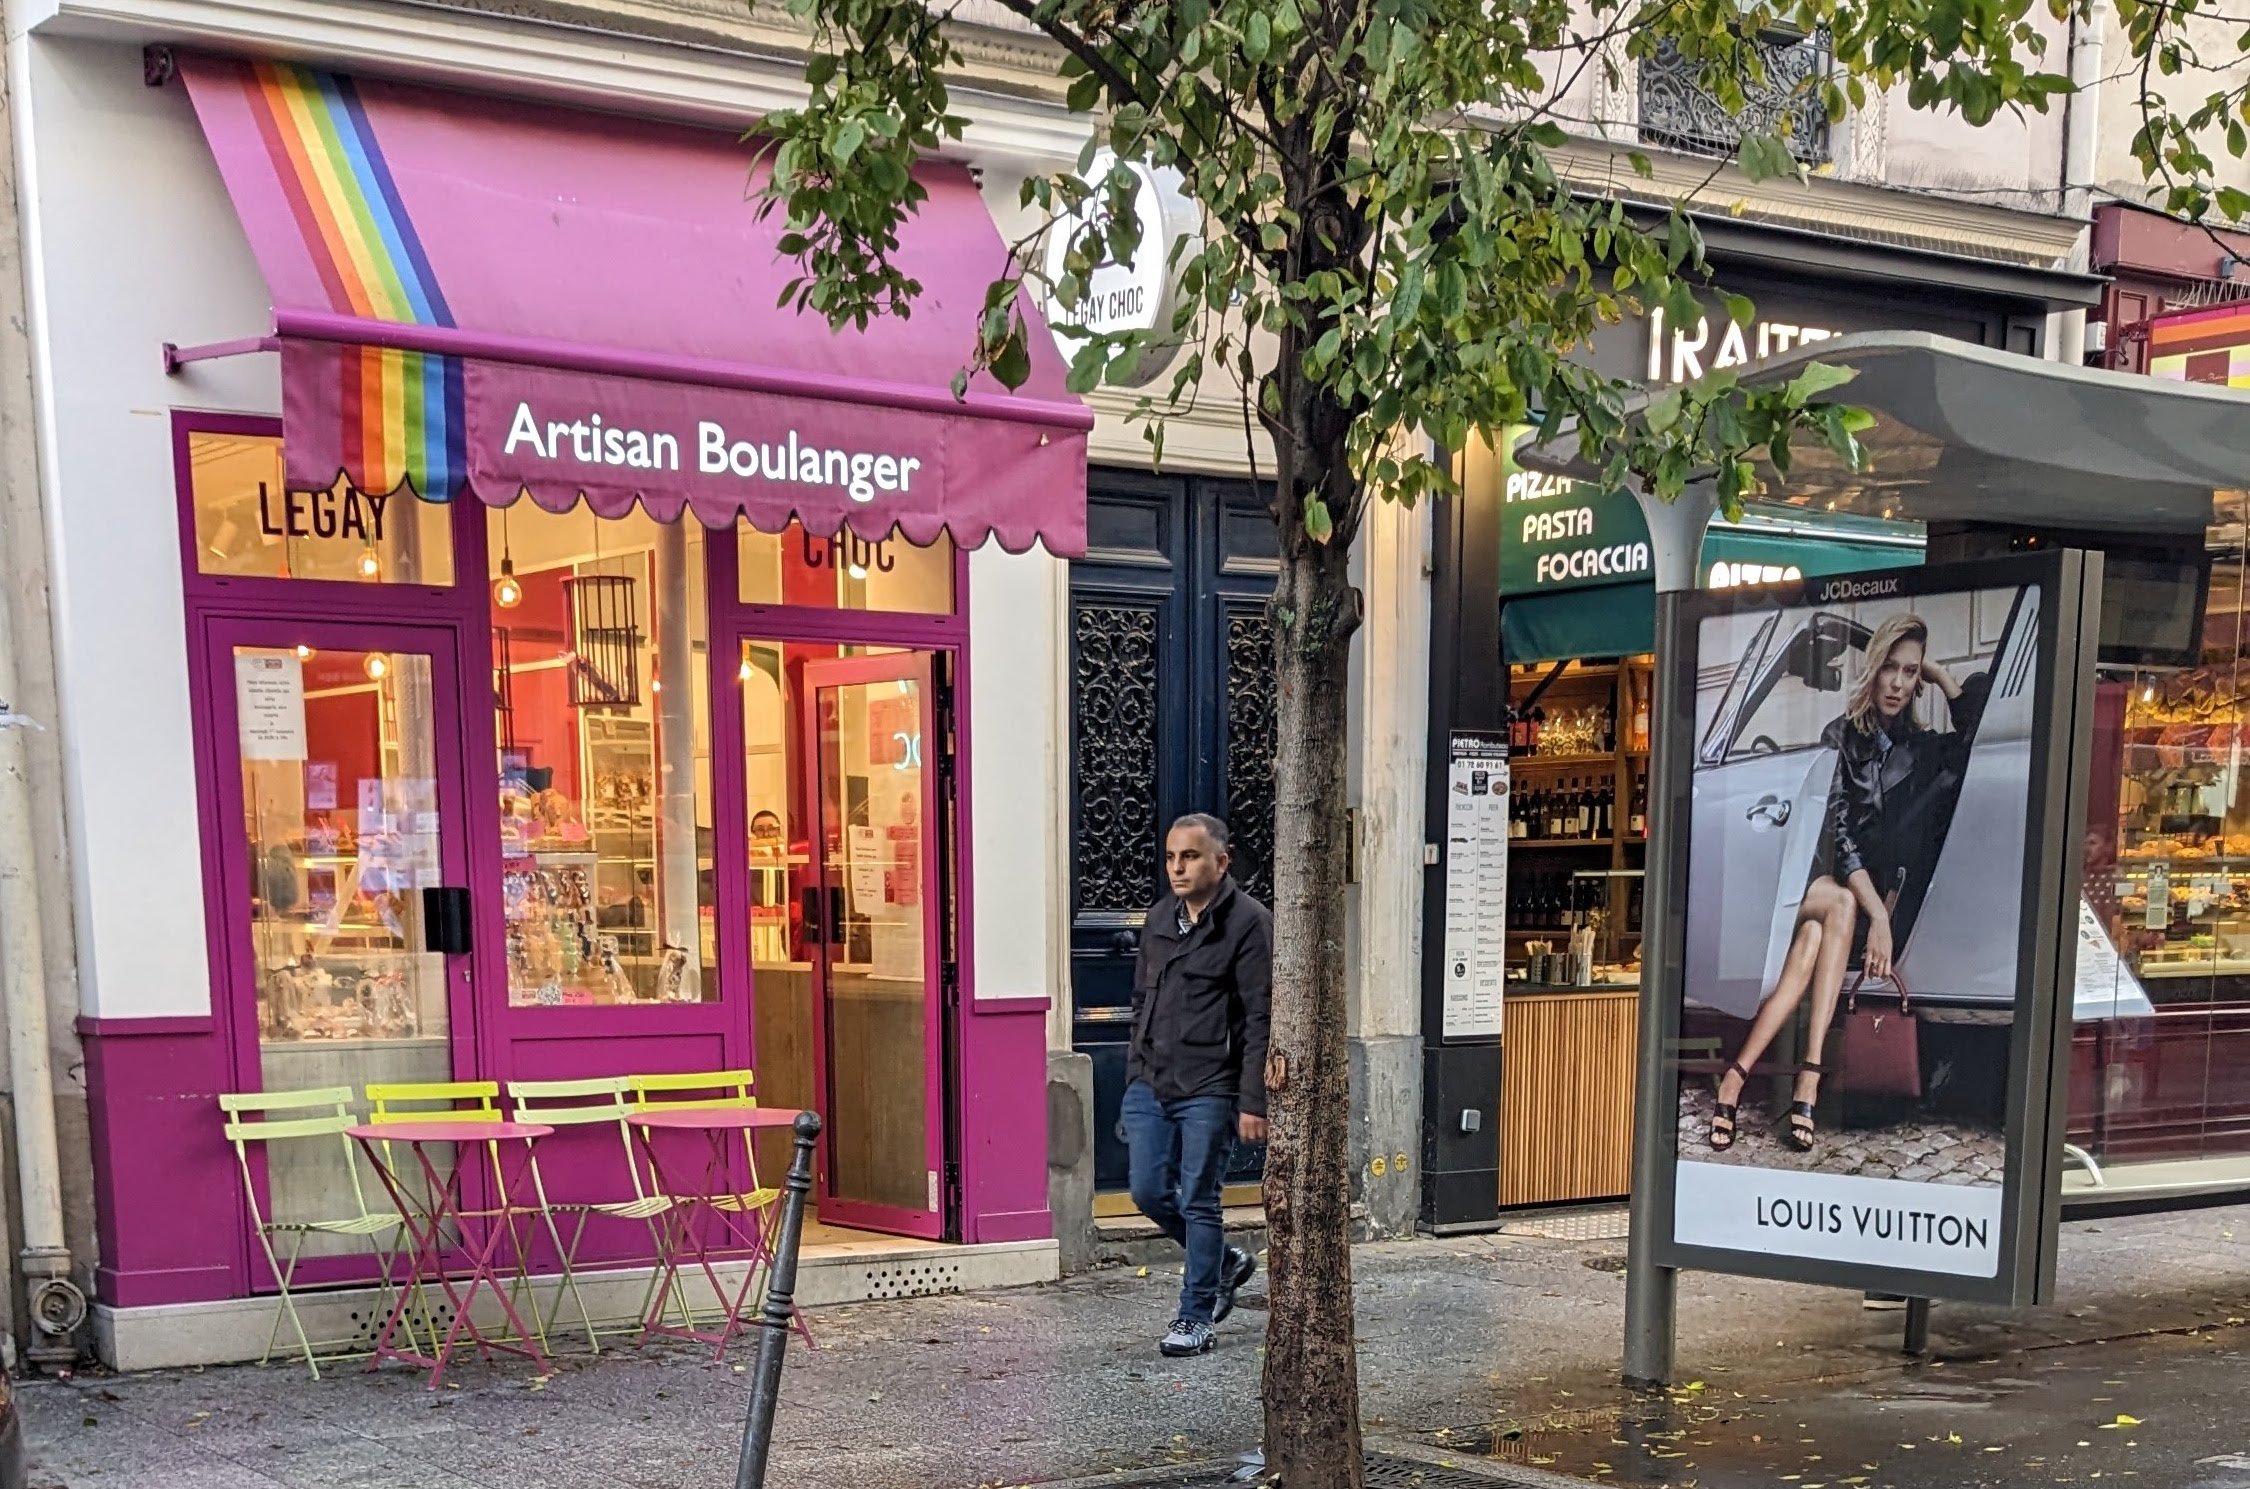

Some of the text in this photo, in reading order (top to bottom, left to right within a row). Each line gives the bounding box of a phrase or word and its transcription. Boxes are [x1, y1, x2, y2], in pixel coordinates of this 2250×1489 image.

[1109, 286, 1143, 320] CHOC
[504, 402, 920, 502] Artisan Boulanger
[259, 481, 894, 572] LEGAY CHOC
[1523, 507, 1593, 542] PASTA
[1537, 542, 1648, 582] FOCACCIA
[1820, 578, 1898, 600] JCDecaux
[1757, 1196, 1988, 1250] LOUIS VUITTON
